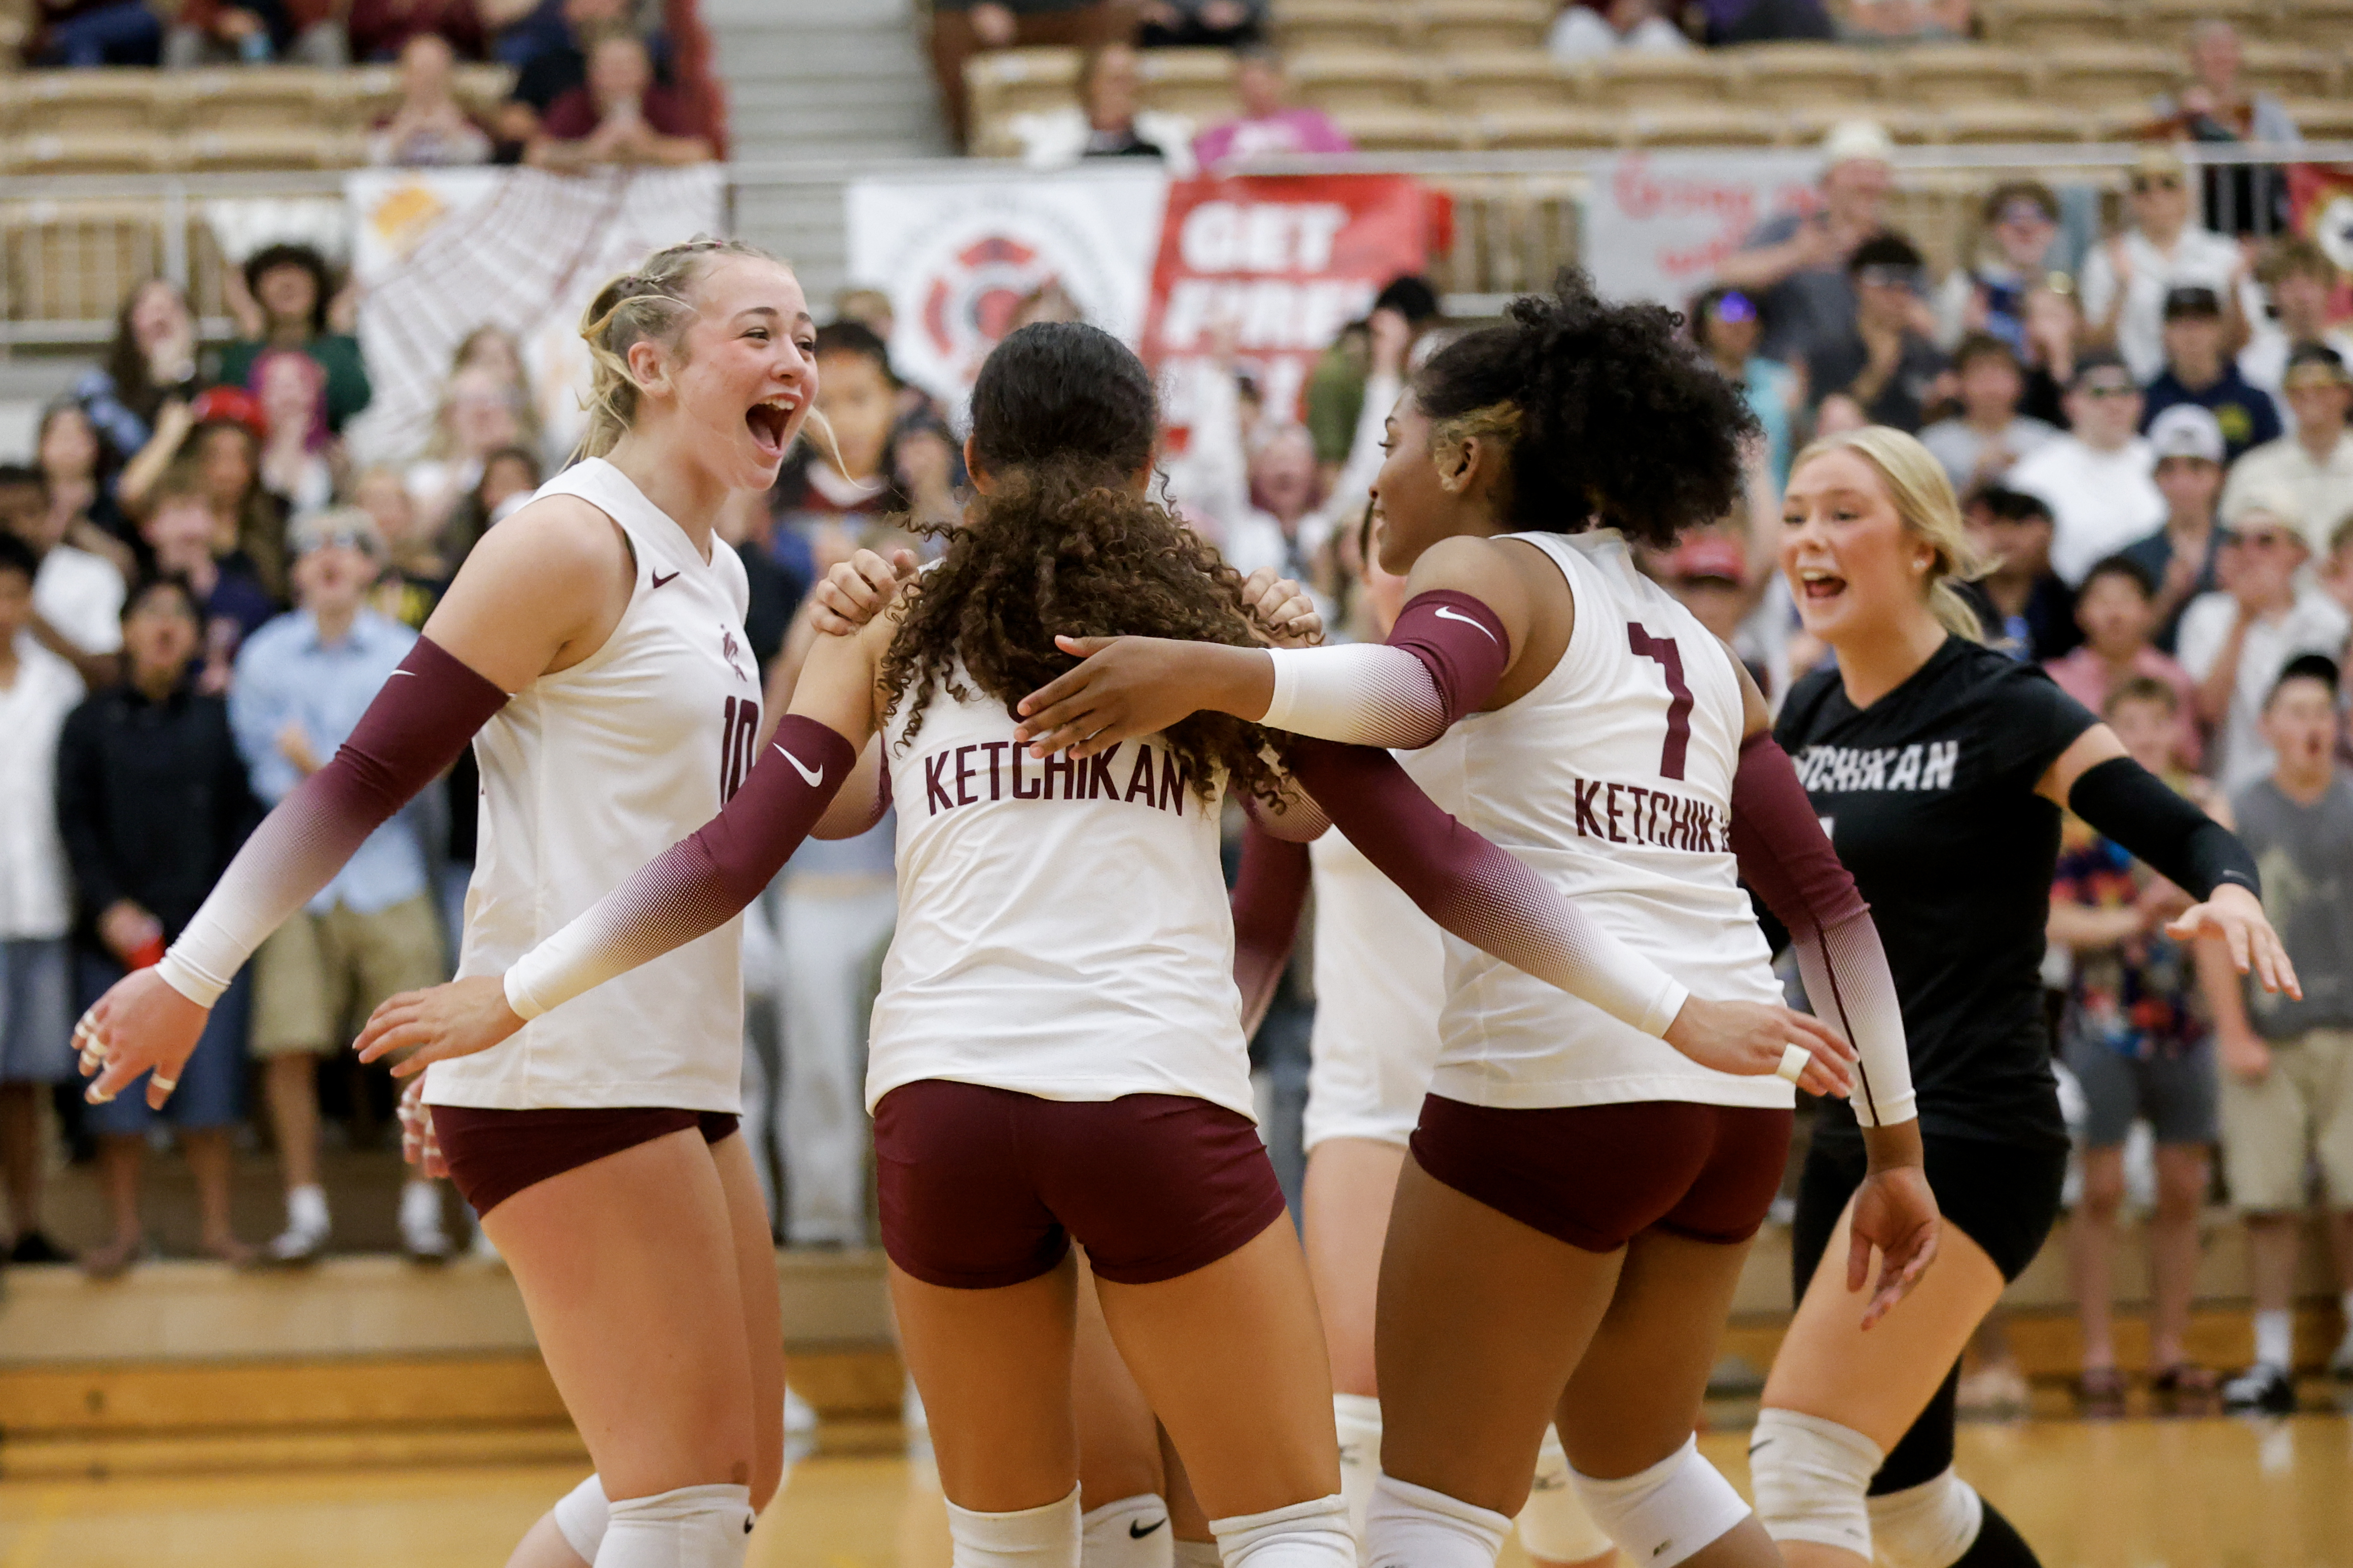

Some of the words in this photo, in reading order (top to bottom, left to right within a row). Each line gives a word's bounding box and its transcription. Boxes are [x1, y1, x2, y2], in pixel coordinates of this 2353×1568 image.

[1180, 201, 1349, 274] GET
[720, 695, 759, 805] 10
[925, 741, 1187, 817] KETCHIKAN
